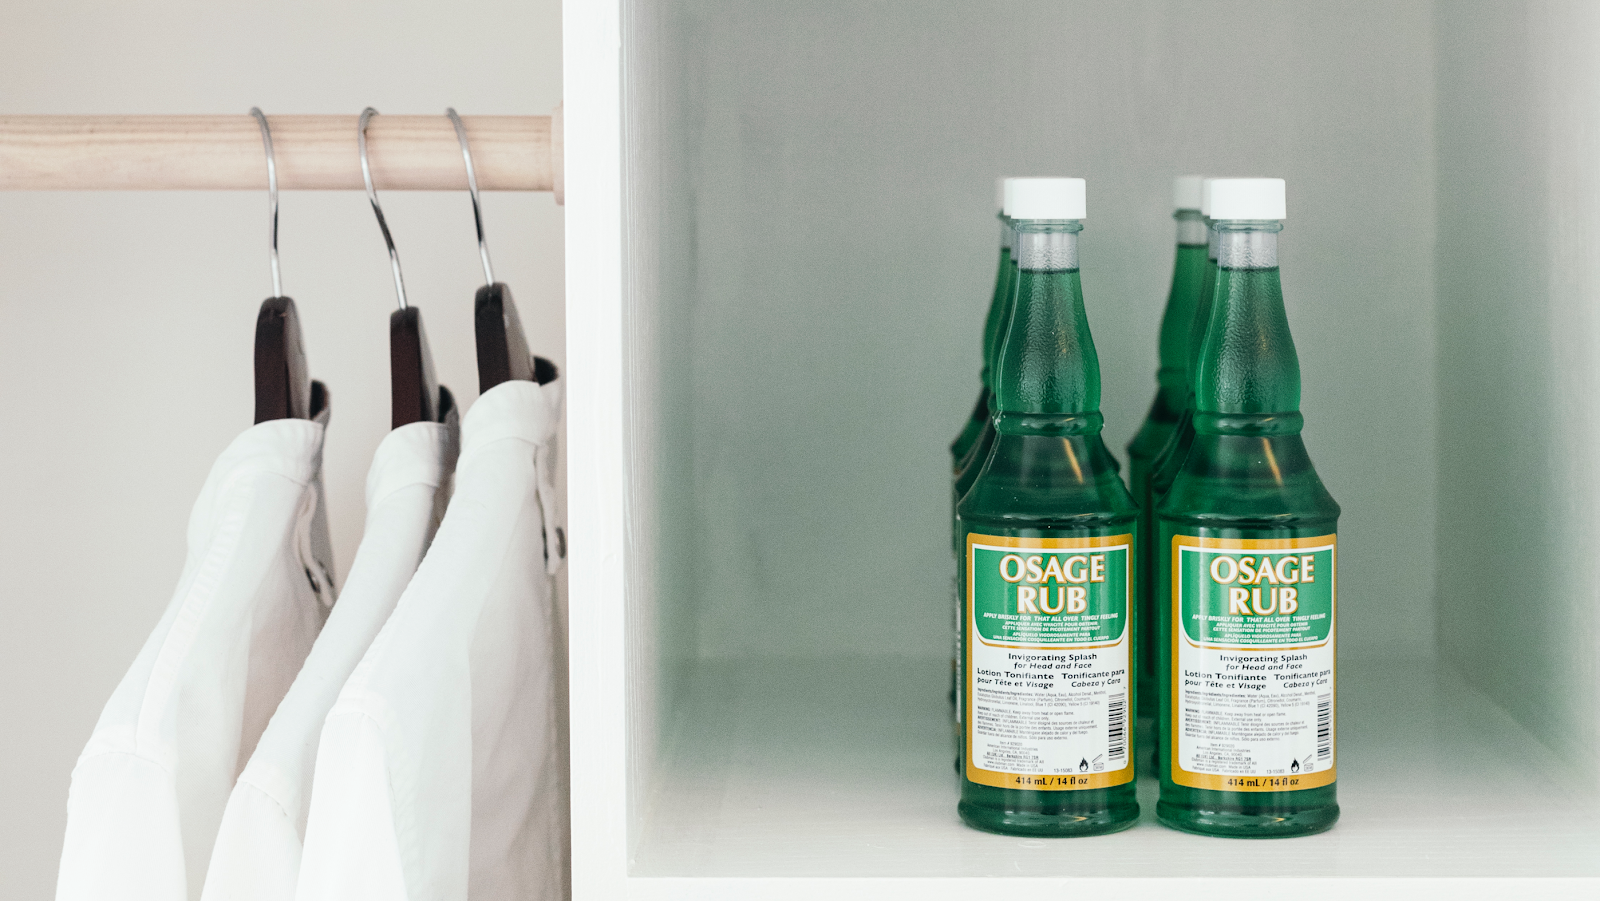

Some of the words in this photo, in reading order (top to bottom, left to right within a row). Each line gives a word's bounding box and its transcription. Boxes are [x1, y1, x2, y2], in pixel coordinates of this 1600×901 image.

[999, 554, 1105, 584] OSAGE
[1210, 554, 1315, 585] OSAGE
[1017, 585, 1088, 615] RUB
[1228, 586, 1298, 616] RUB
[1008, 653, 1066, 662] Invigorating
[1068, 653, 1097, 662] Splash
[1220, 655, 1278, 664] Invigorating
[1281, 654, 1308, 662] Splash
[977, 668, 1001, 677] Lotion
[1004, 671, 1054, 679] Tonifiante
[1061, 671, 1109, 679] Tonificante
[1112, 669, 1124, 678] para
[1185, 670, 1212, 678] Lotion
[1274, 672, 1318, 680] Tonificante
[1282, 778, 1287, 786] fl
